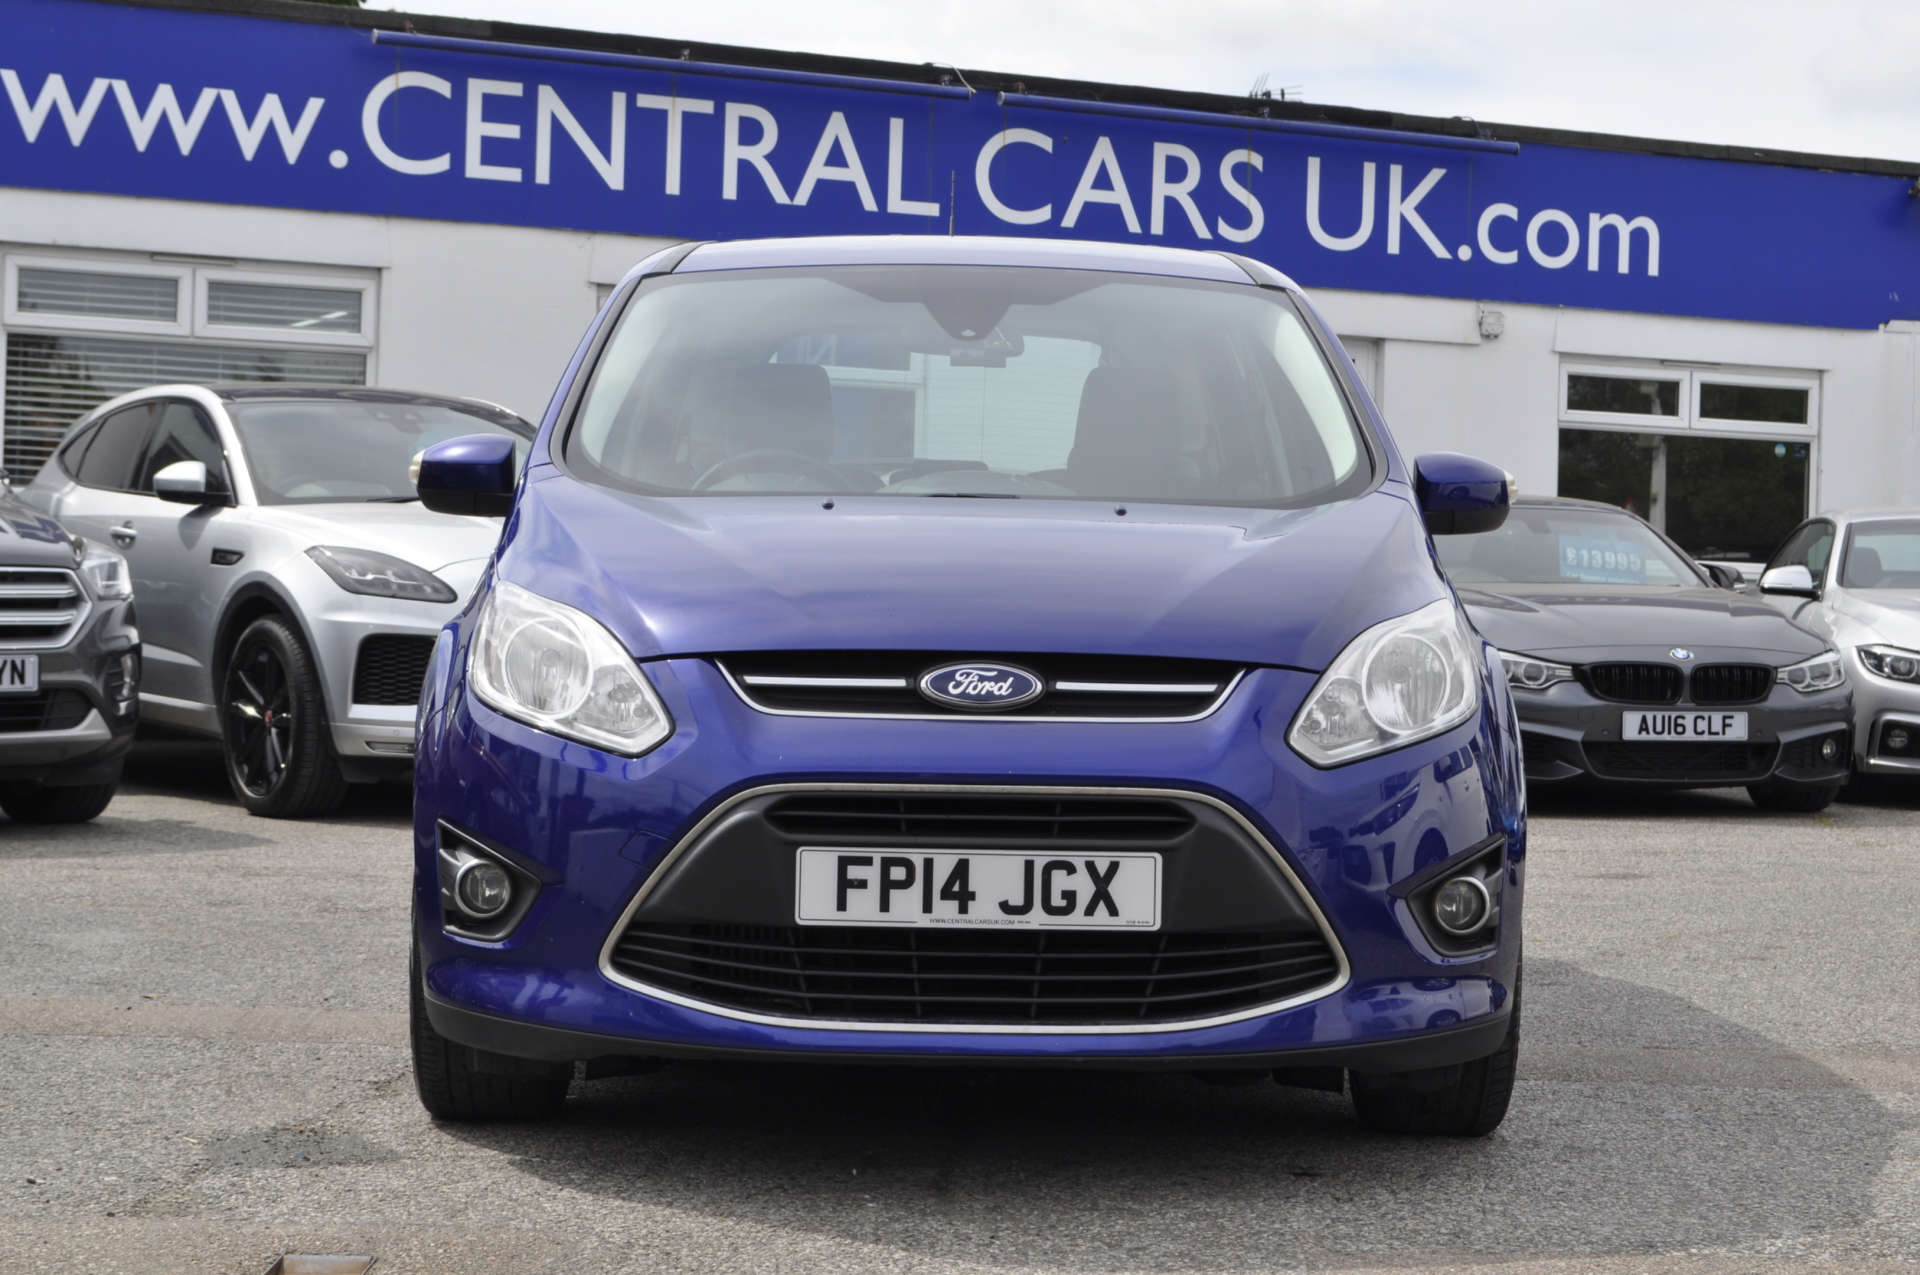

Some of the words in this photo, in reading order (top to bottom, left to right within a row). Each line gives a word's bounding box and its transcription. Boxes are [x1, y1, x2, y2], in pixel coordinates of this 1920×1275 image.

[975, 127, 1266, 244] CARS
[1305, 155, 1661, 277] UK.com
[948, 669, 1014, 695] Ford
[1638, 714, 1687, 736] AU16
[1693, 714, 1735, 736] CLF
[836, 855, 977, 914] FP14
[997, 859, 1121, 917] JGX
